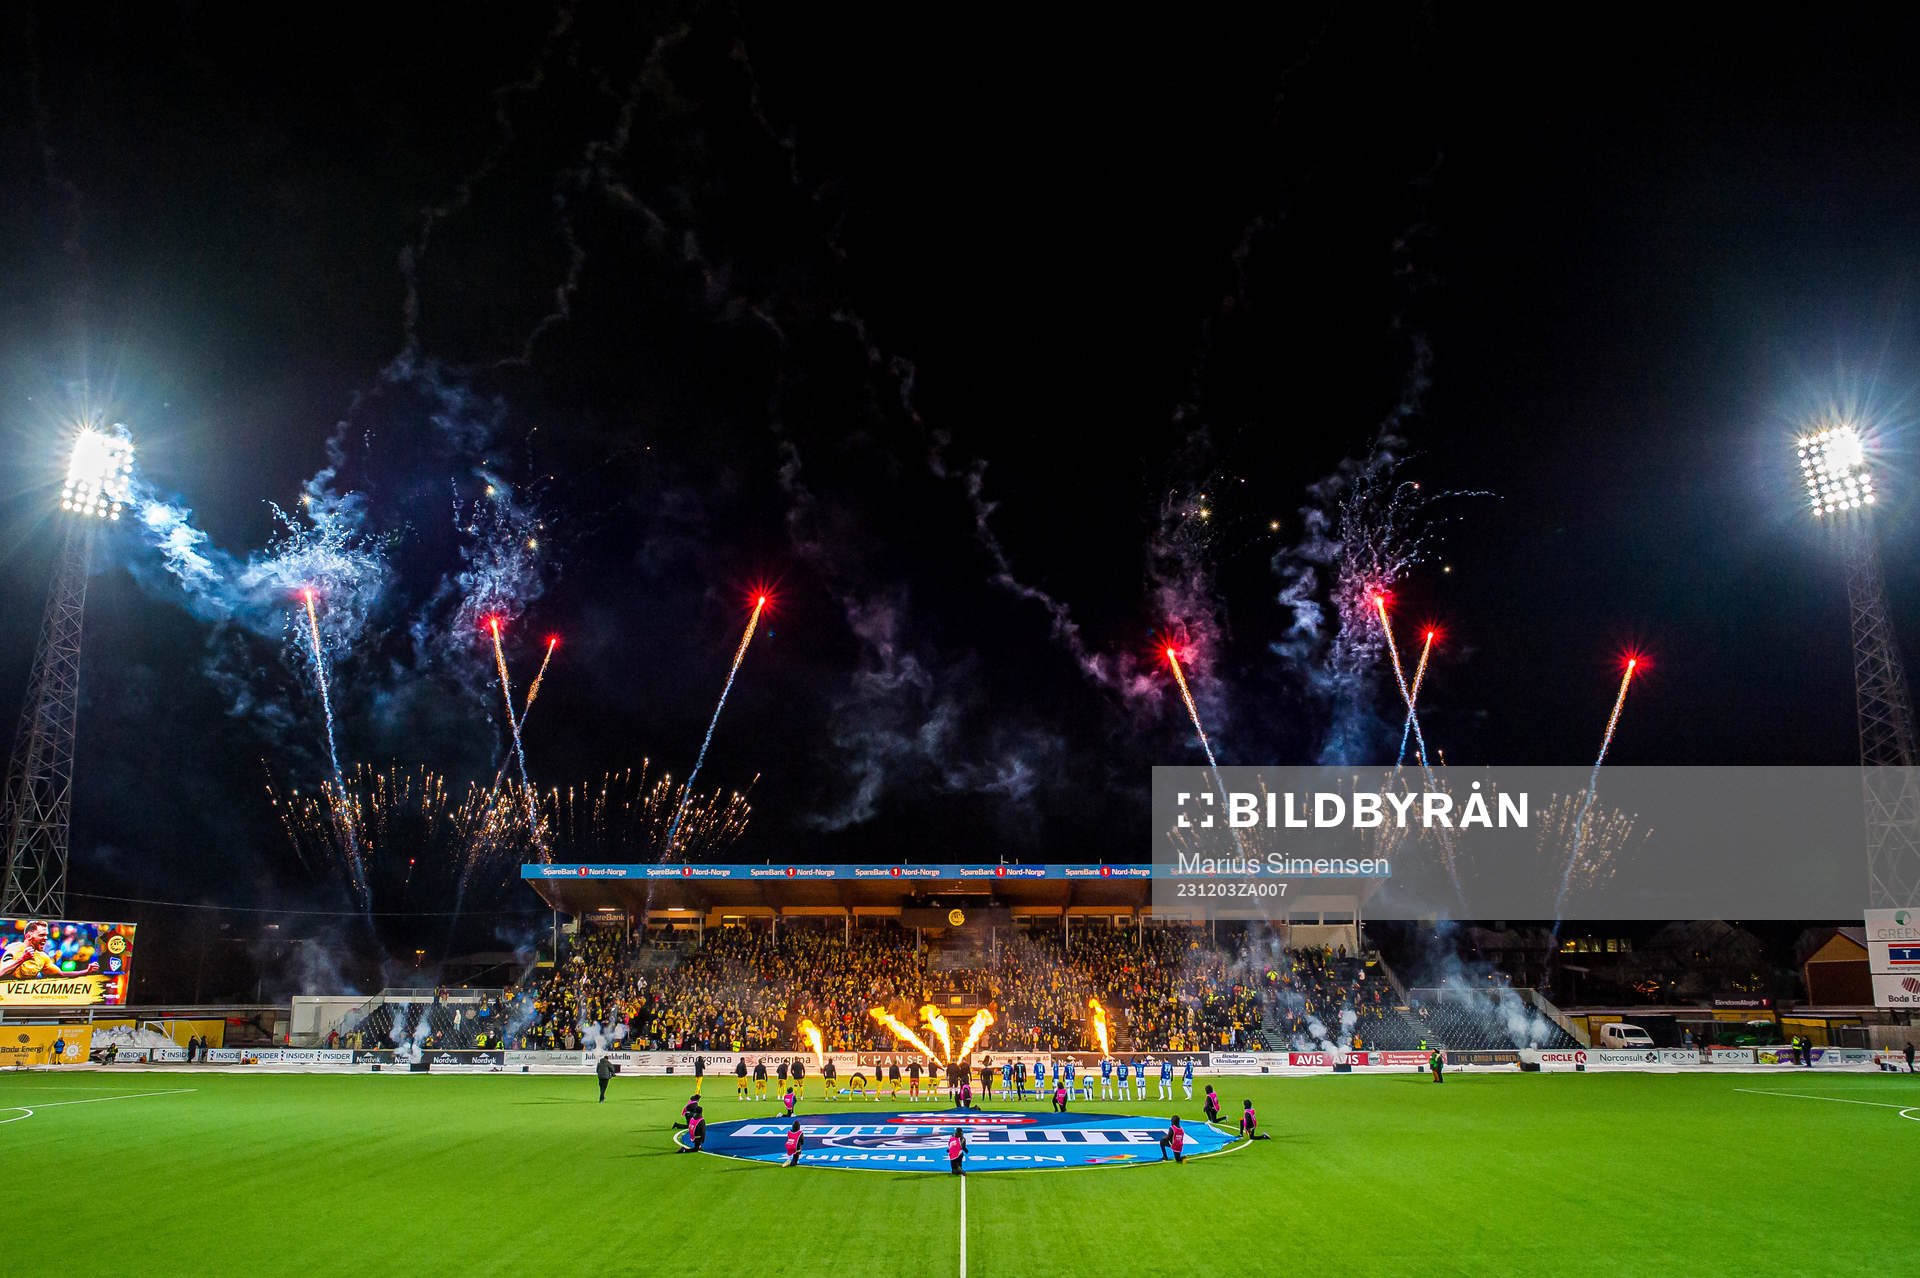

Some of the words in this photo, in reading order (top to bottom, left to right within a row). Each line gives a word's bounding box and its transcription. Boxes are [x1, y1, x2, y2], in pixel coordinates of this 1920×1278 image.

[544, 868, 577, 876] SpareBank
[589, 868, 627, 877] Nord-Norge
[646, 868, 681, 876] SpareBank
[692, 868, 731, 877] Nord-Norge
[750, 868, 785, 876] SpareBank
[797, 868, 835, 877] Nord-Norge
[855, 868, 890, 876] SpareBank
[901, 868, 940, 877] Nord-Norge
[960, 868, 995, 876] SpareBank
[1006, 868, 1046, 877] Nord-Norge
[1065, 868, 1100, 876] SpareBank
[1111, 868, 1150, 877] Nord-Norge
[7, 983, 92, 994] VELKOMMEN
[1888, 994, 1910, 1003] Bodø
[167, 1051, 188, 1059] INSID
[356, 1055, 381, 1064] Nordvik
[433, 1055, 459, 1064] Nordvik
[471, 1055, 497, 1064] Nordvik
[1333, 1055, 1359, 1064] AVIS
[1541, 1054, 1573, 1062] CIRCLE
[1600, 1052, 1643, 1062] Norconsult
[1296, 1055, 1323, 1065] AVIS
